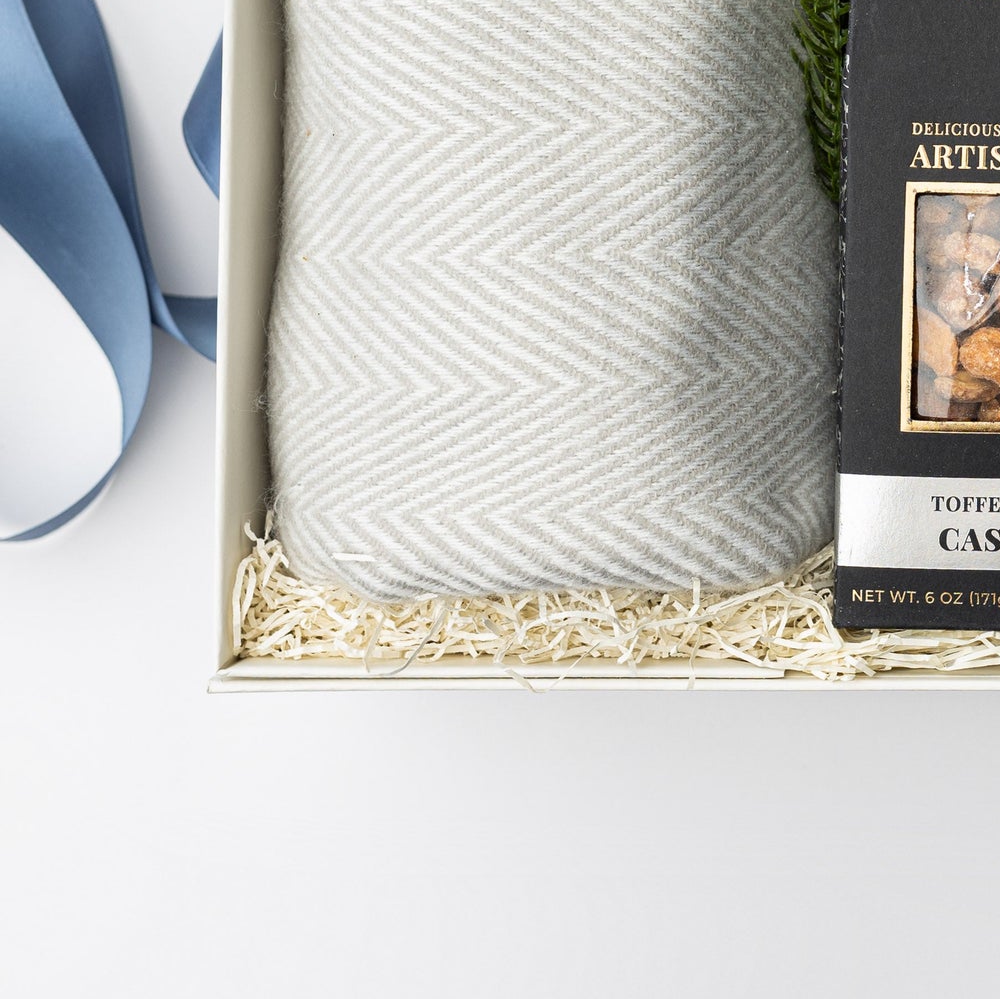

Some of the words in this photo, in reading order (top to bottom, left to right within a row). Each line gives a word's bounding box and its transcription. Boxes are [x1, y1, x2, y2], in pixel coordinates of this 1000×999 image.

[853, 590, 884, 602] NET
[890, 591, 919, 603] WT.
[925, 592, 934, 603] 6
[941, 592, 963, 604] OZ
